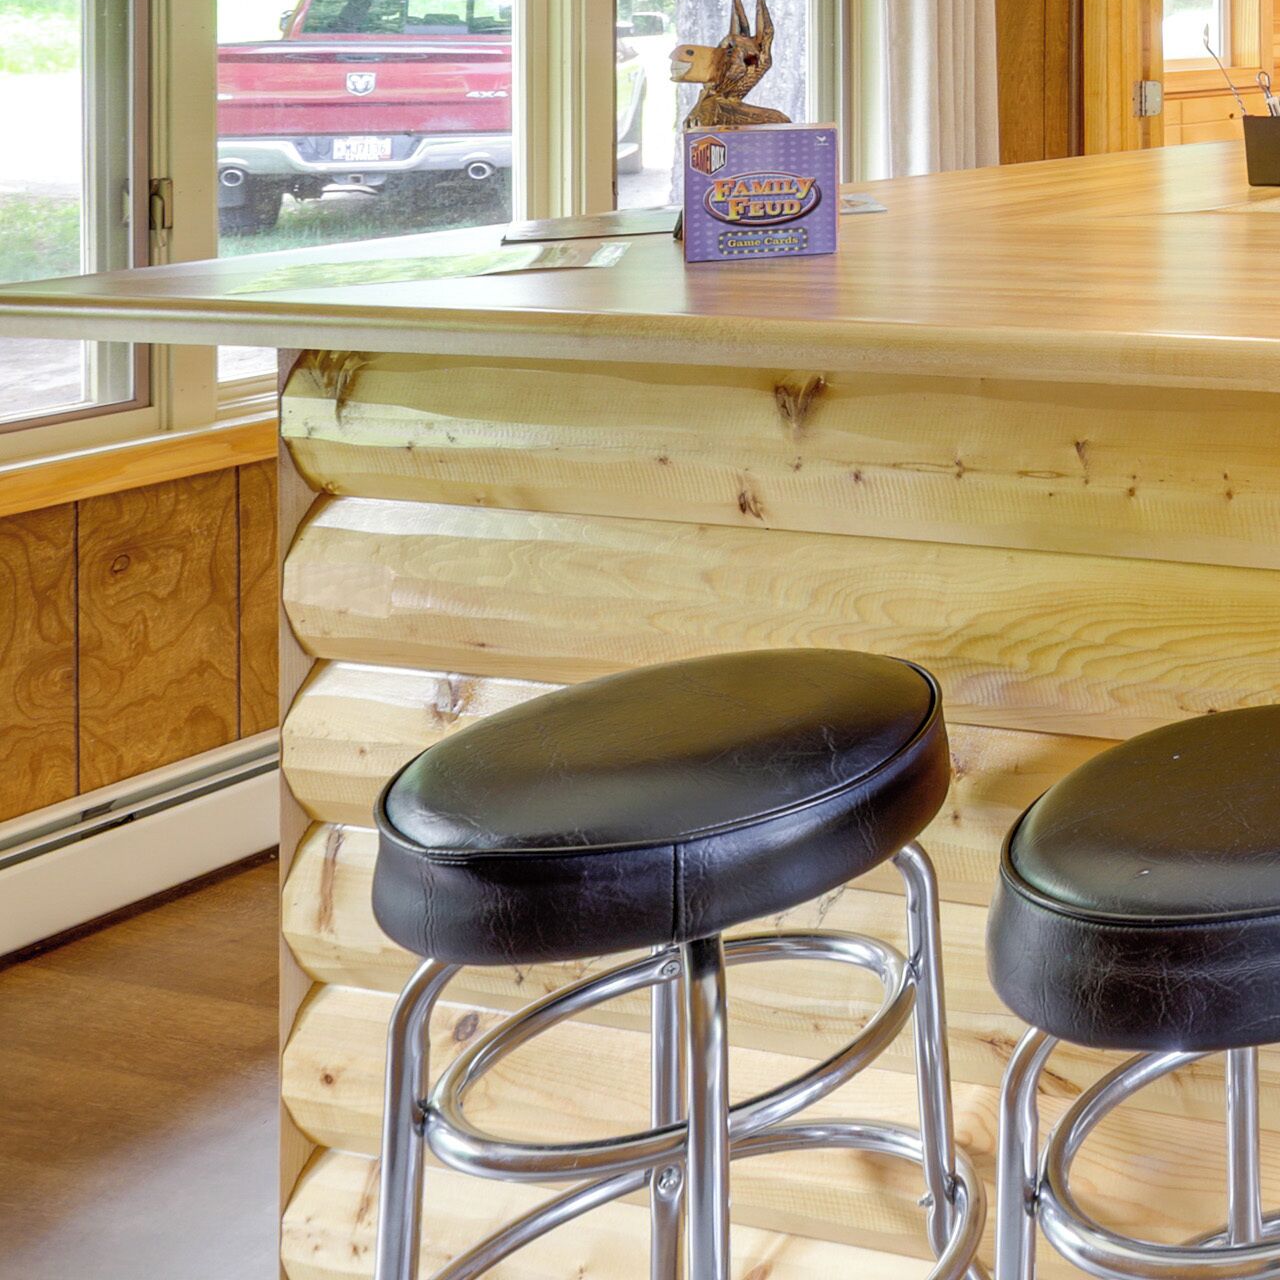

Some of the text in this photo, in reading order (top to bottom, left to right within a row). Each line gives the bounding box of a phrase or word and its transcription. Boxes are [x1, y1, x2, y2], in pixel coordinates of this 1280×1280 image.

[713, 177, 816, 202] FAMILY
[726, 197, 802, 221] FEUD
[728, 237, 799, 248] Game Cards
